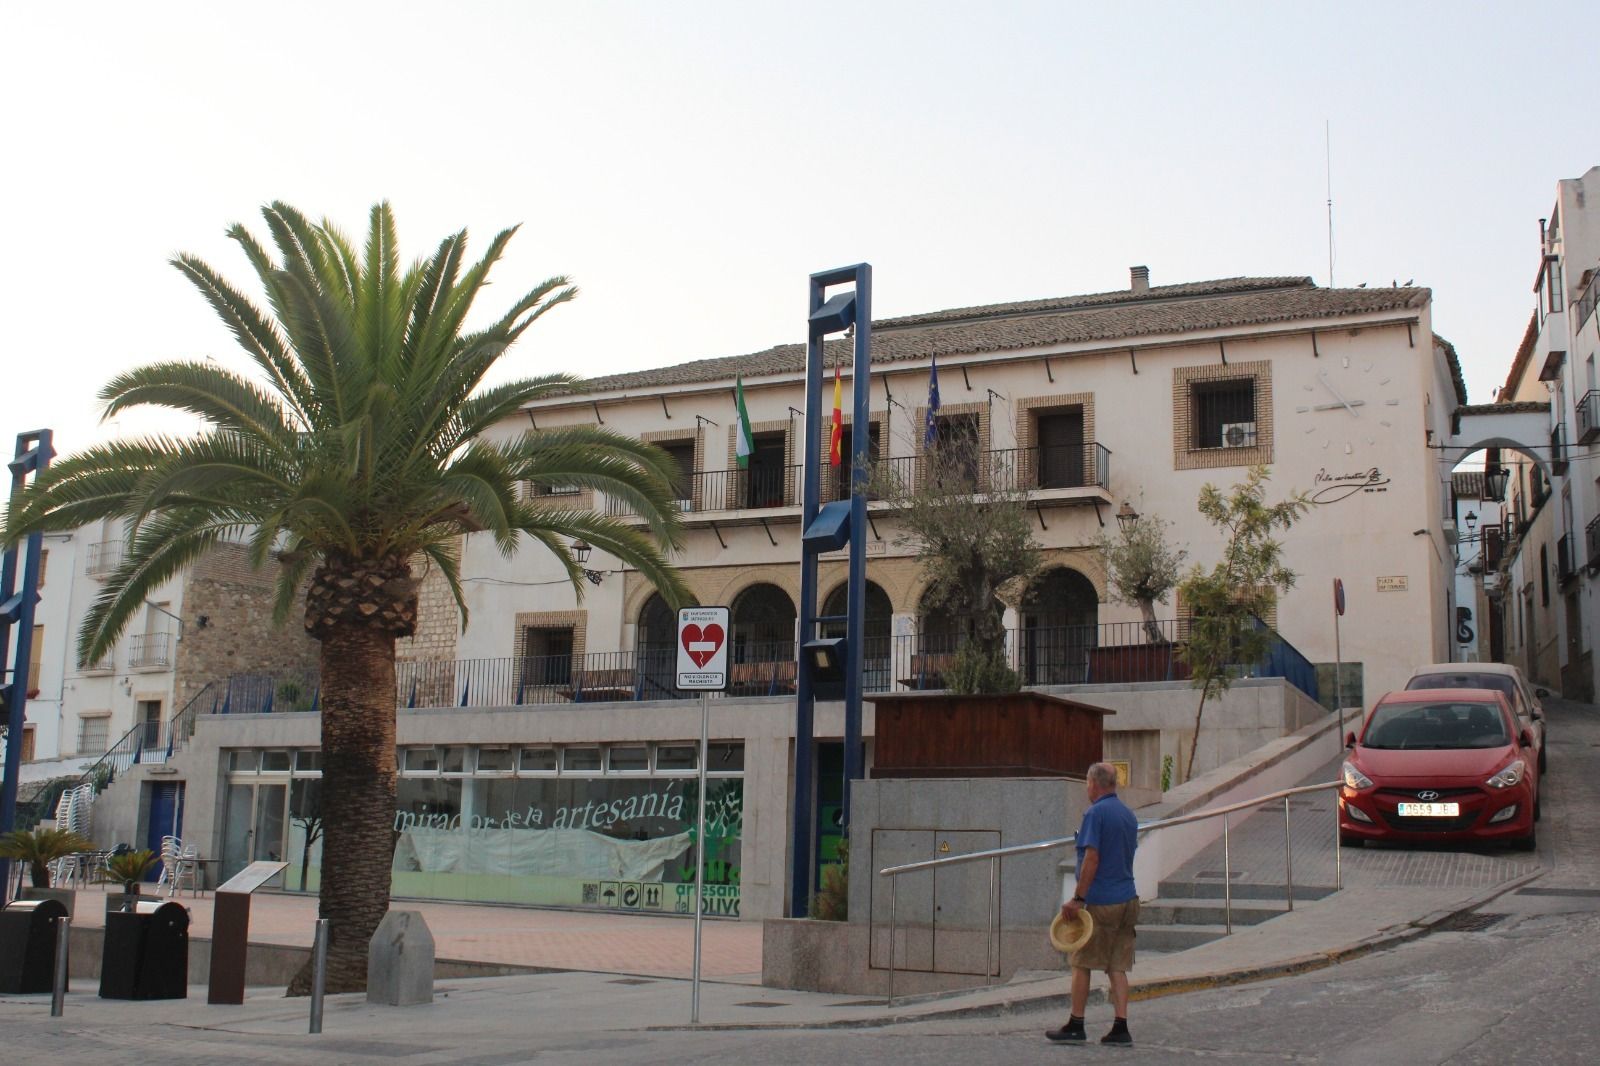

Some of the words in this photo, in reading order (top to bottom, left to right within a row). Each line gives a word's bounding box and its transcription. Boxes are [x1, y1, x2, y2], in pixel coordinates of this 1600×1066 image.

[523, 806, 543, 826] la
[553, 781, 684, 831] artesanía
[676, 884, 741, 897] aresan
